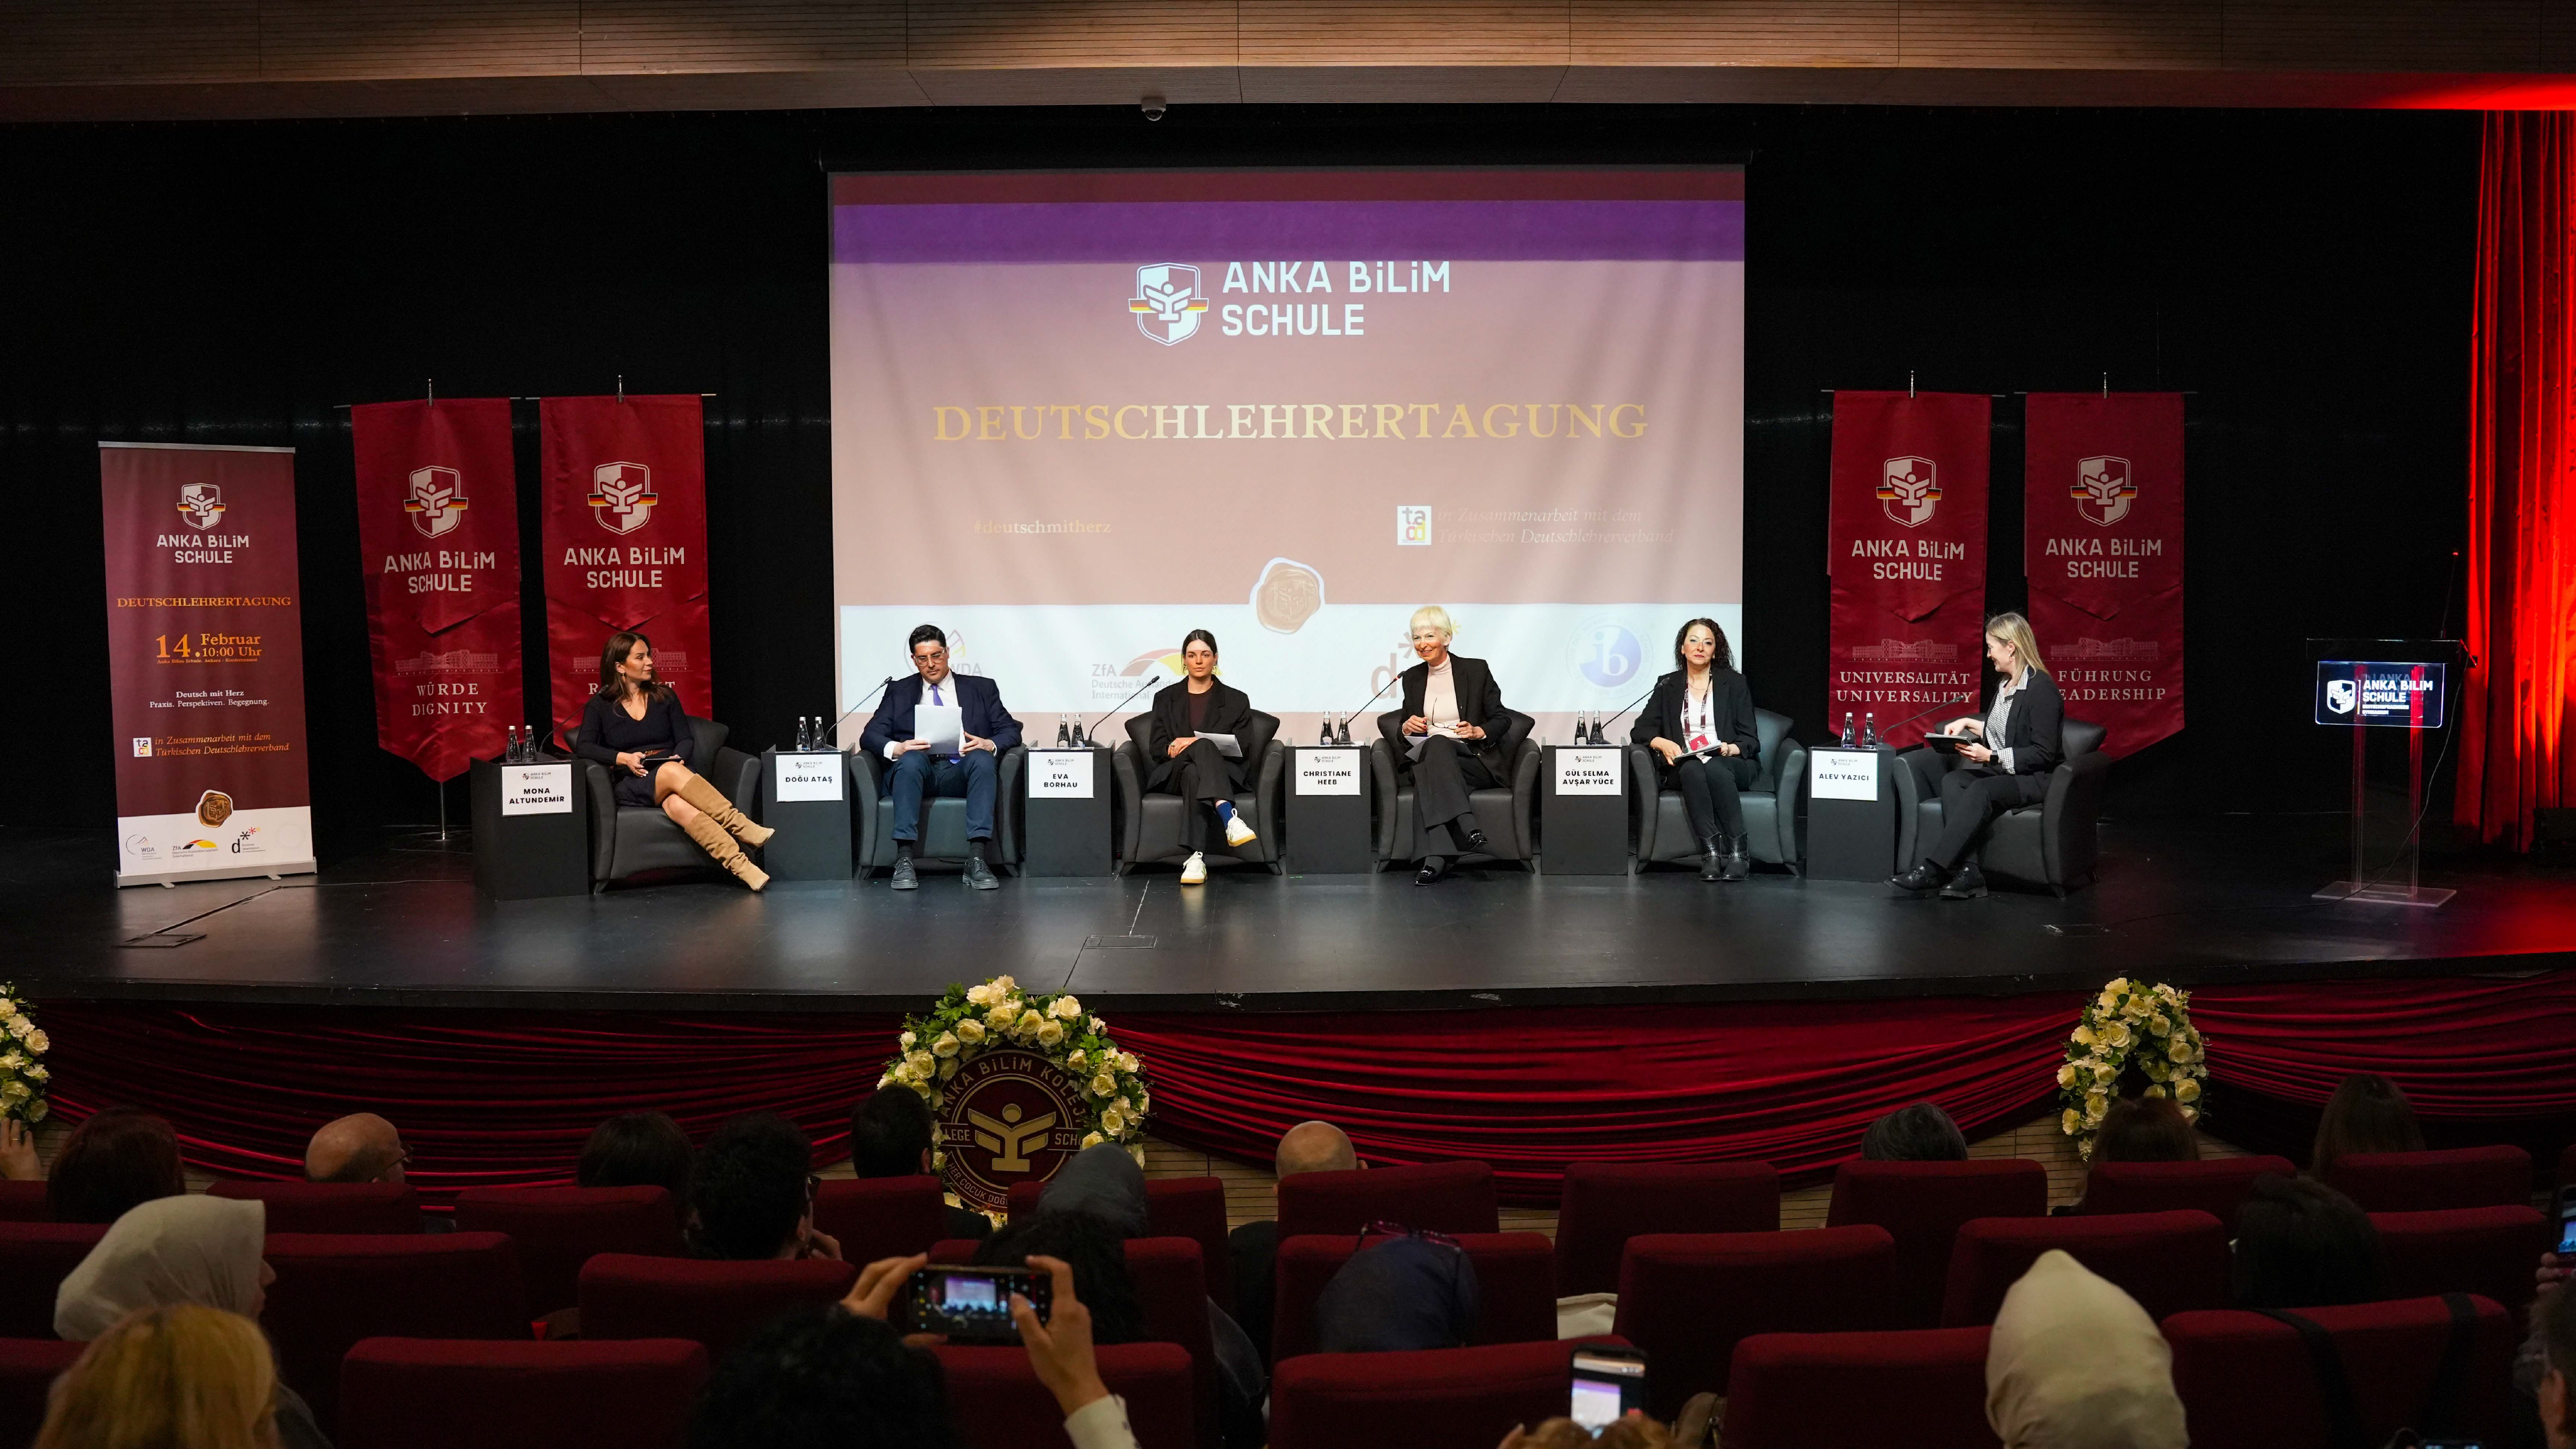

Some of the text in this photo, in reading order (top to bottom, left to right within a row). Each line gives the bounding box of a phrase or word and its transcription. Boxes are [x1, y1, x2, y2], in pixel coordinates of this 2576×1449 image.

[1222, 261, 1332, 294] ANKA
[1222, 303, 1365, 336] SCHULE
[933, 403, 1649, 441] DEUTSCHLEHRERTAGUNG
[1458, 507, 1578, 522] Zusammenarbeit
[1584, 507, 1607, 522] mit
[1613, 507, 1642, 522] dem
[974, 519, 1112, 534] #deutschmitherz
[156, 535, 202, 547] ANKA
[1521, 529, 1674, 543] Deutschlehrerverband
[1852, 540, 1909, 558] ANKA
[2045, 538, 2102, 556] ANKA
[175, 551, 232, 564] SCHULE
[384, 551, 431, 573] ANKA
[564, 547, 621, 566] ANKA
[1873, 563, 1942, 581] SCHULE
[2067, 561, 2139, 578] SCHULE
[408, 574, 472, 593] SCHULE
[587, 570, 663, 589] SCHULE
[117, 596, 292, 607] DEUTSCHLEHRERTAGUNG
[200, 633, 261, 645] Februar
[202, 647, 262, 657] 10:00 Uhr
[1092, 663, 1117, 677] ZfA
[2058, 668, 2152, 682] FÜHRUNG
[1092, 679, 1133, 688] Deutsche
[1840, 671, 1970, 685] UNIVERSALITÄT
[2363, 679, 2397, 690] ANKA
[417, 681, 478, 696] WÜRDE
[1092, 690, 1150, 700] International
[2059, 688, 2166, 701] EADERSHIP
[1836, 690, 1973, 703] UNIVERSALITY
[2362, 692, 2407, 703] SCHULE
[178, 700, 225, 708] Perspektiven.
[412, 702, 488, 716] DIGNITY
[167, 734, 235, 744] Zusammenarbeit
[238, 733, 252, 741] mit
[204, 743, 290, 755] Deutschlehrerverband
[509, 795, 565, 804] ALTUNDEMİR
[941, 1072, 974, 1118] ANKA
[947, 1162, 961, 1180] HER
